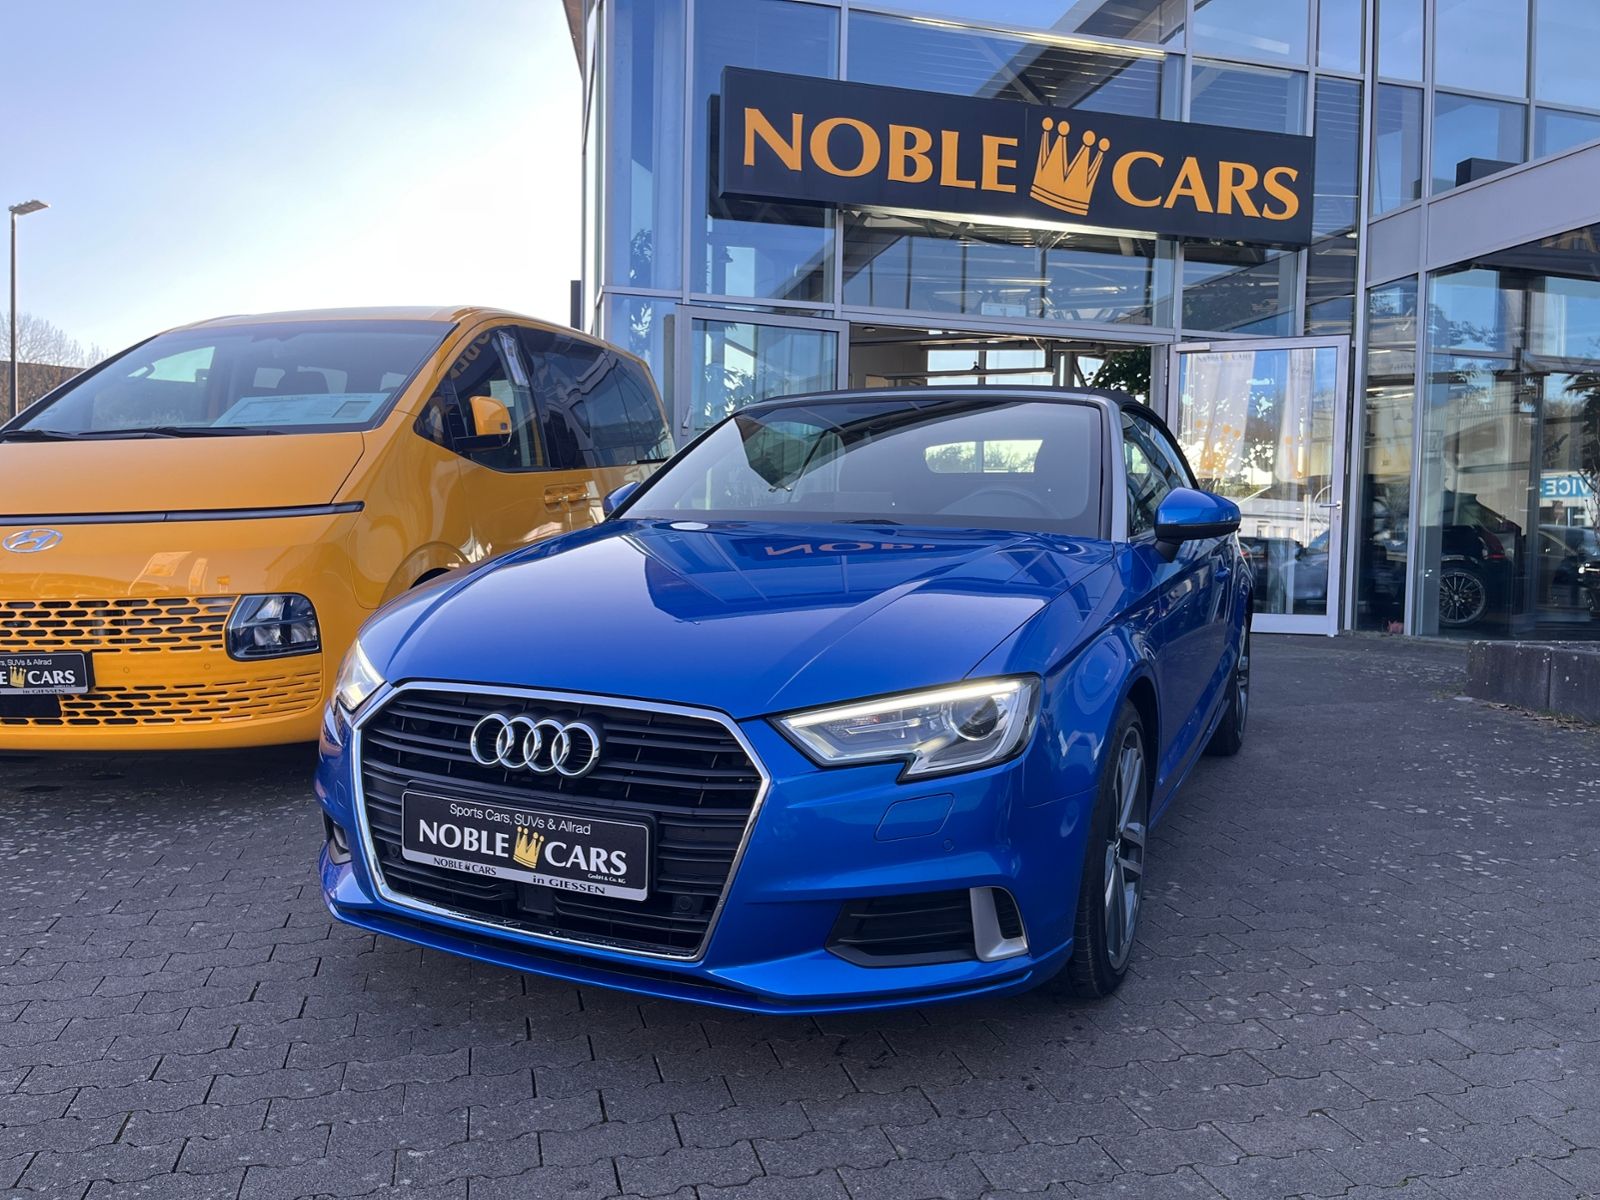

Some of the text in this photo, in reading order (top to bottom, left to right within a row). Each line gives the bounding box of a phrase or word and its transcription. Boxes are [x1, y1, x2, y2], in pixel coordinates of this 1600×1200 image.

[743, 106, 1300, 221] NOBLE CARS
[27, 670, 75, 684] CARS
[449, 803, 592, 835] Sports Cars, SUVs & Allrad
[418, 819, 628, 876] NOBLE CARS
[433, 857, 498, 876] NOBLE CARS
[532, 874, 606, 895] in GIESSEN
